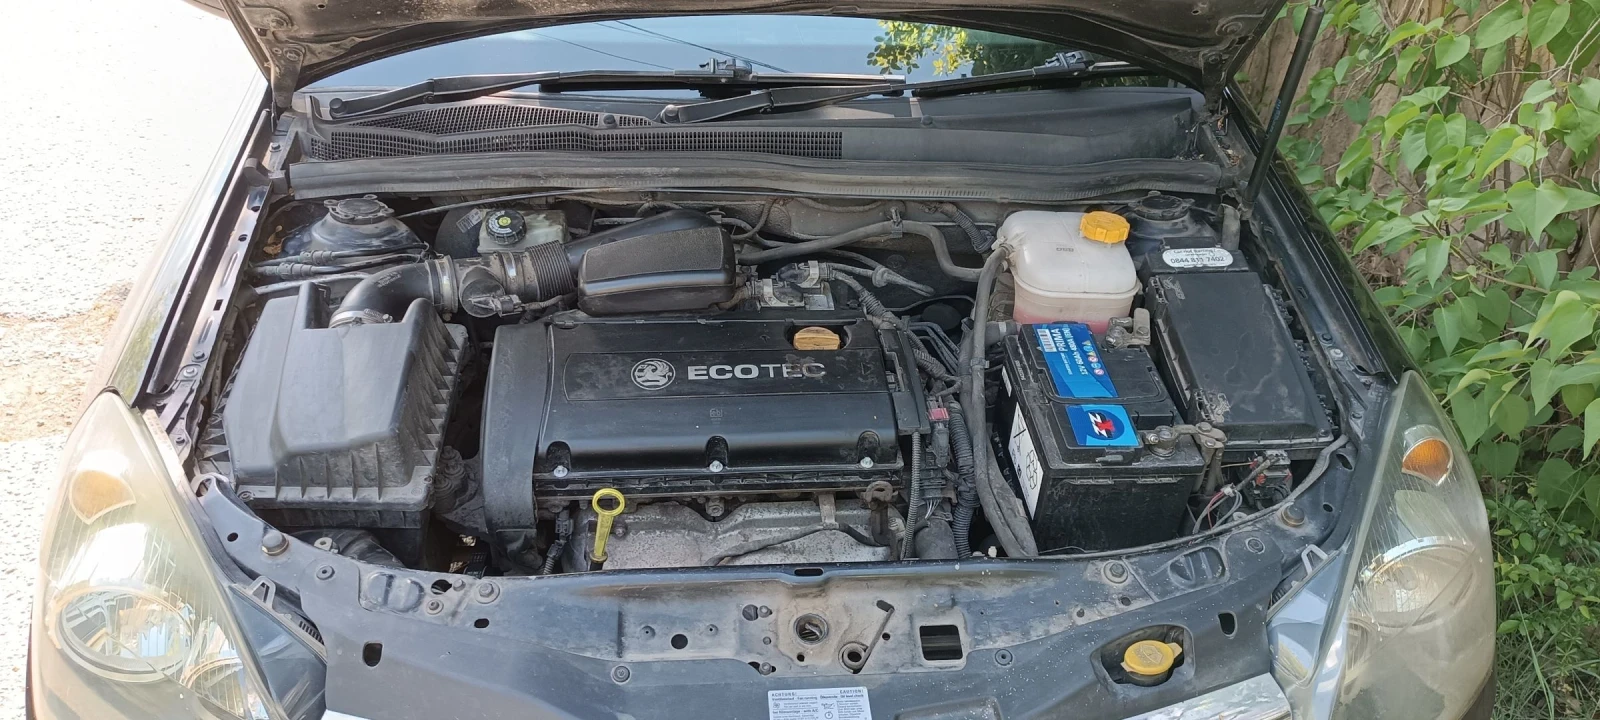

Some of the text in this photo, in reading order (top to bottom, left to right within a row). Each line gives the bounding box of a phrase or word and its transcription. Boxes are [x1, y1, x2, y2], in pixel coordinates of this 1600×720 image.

[1051, 328, 1068, 351] PRIMA
[687, 362, 826, 380] ECOTEC
[1077, 364, 1088, 375] 12V
